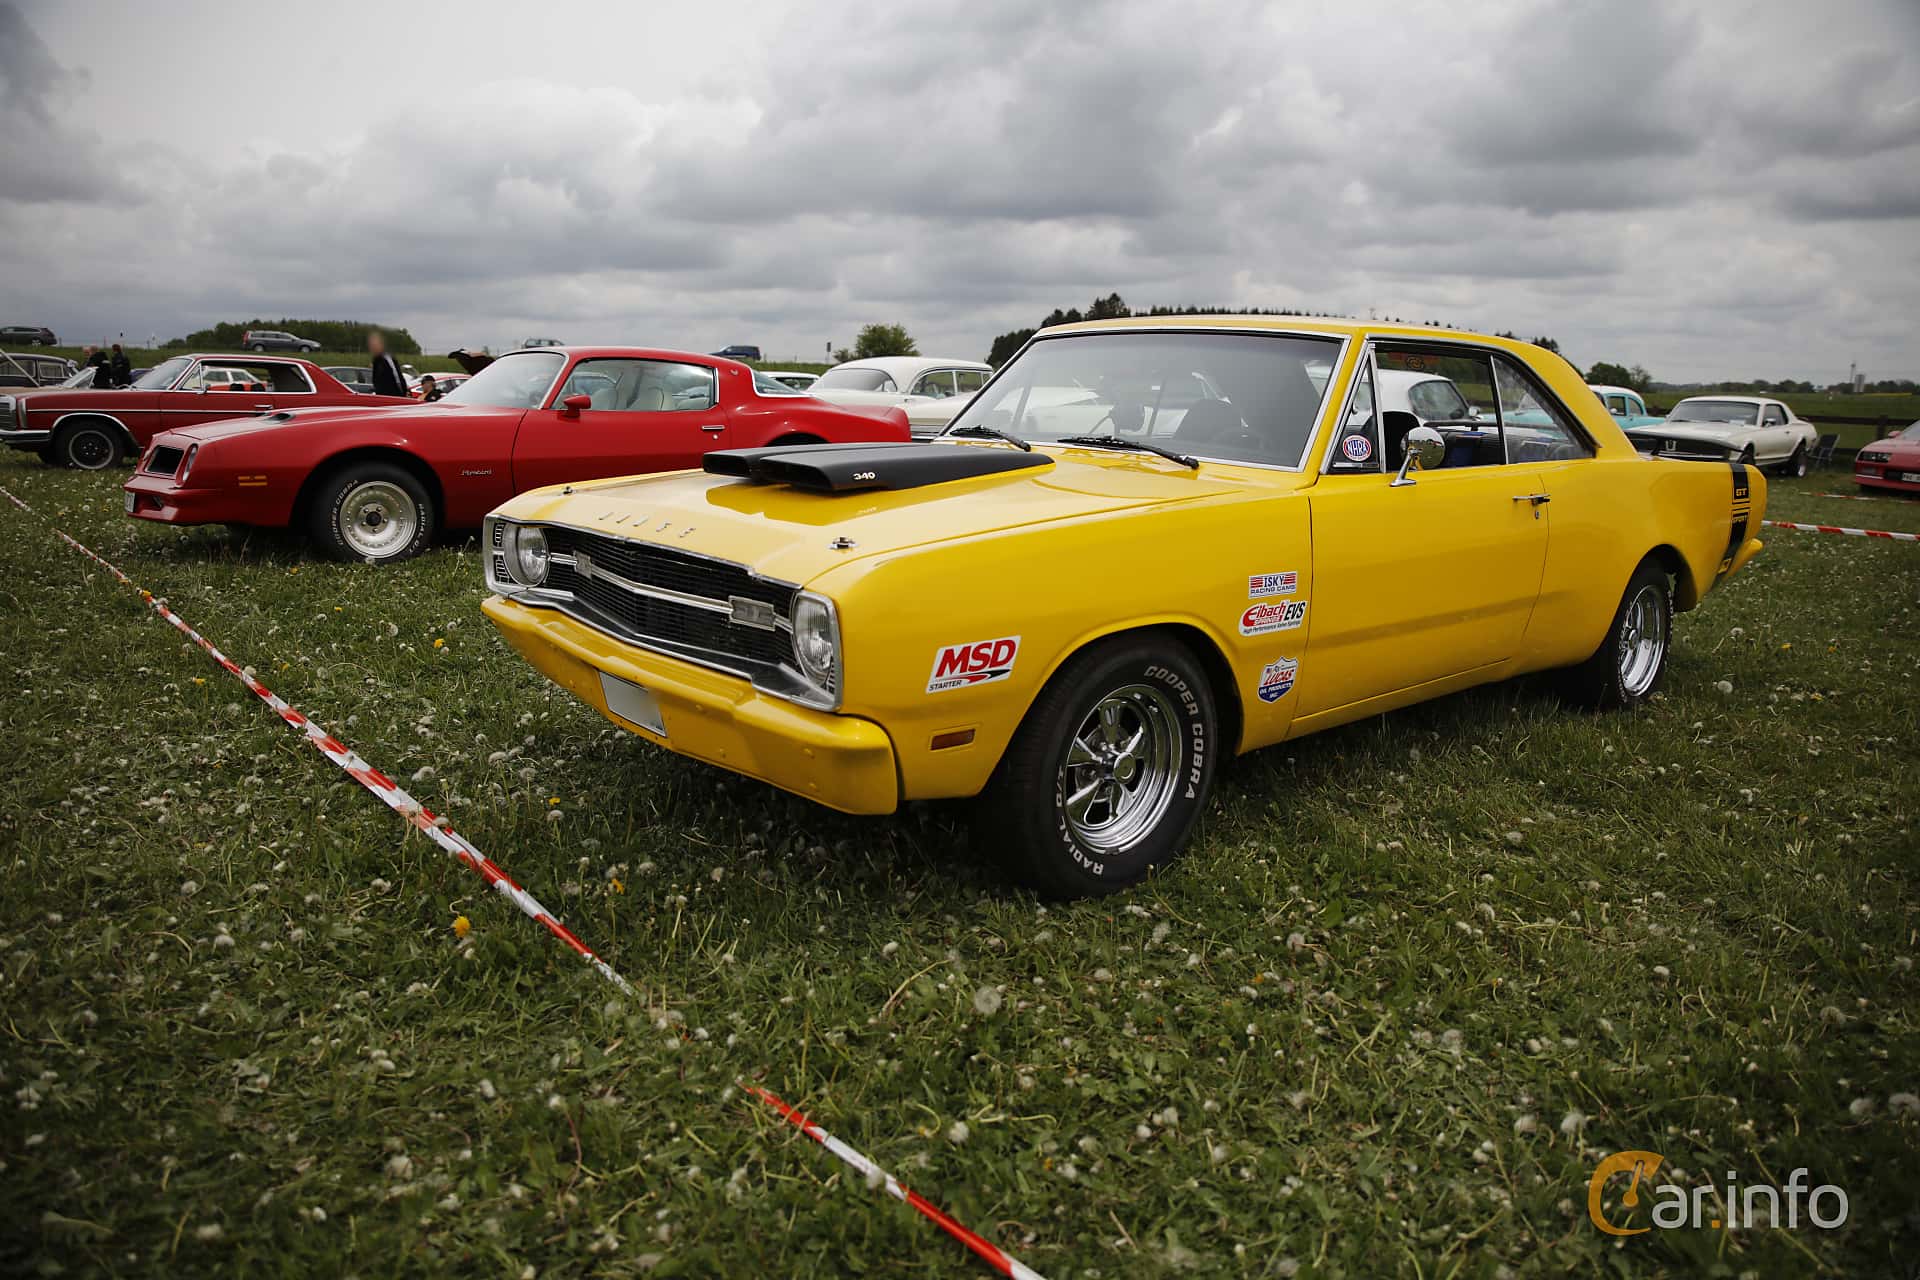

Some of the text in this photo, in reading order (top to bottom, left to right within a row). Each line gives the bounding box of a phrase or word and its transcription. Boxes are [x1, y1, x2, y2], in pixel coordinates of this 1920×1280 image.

[1347, 439, 1368, 456] NHRA
[853, 471, 876, 480] 340
[1736, 488, 1747, 496] GT
[1264, 576, 1284, 587] ISKY
[1251, 586, 1275, 594] RACING
[1284, 602, 1306, 621] EVS
[936, 639, 1017, 678] MSD
[929, 680, 962, 692] STARTER
[1144, 665, 1204, 799] COOPER COBRA
[1060, 816, 1104, 875] RADIAL
